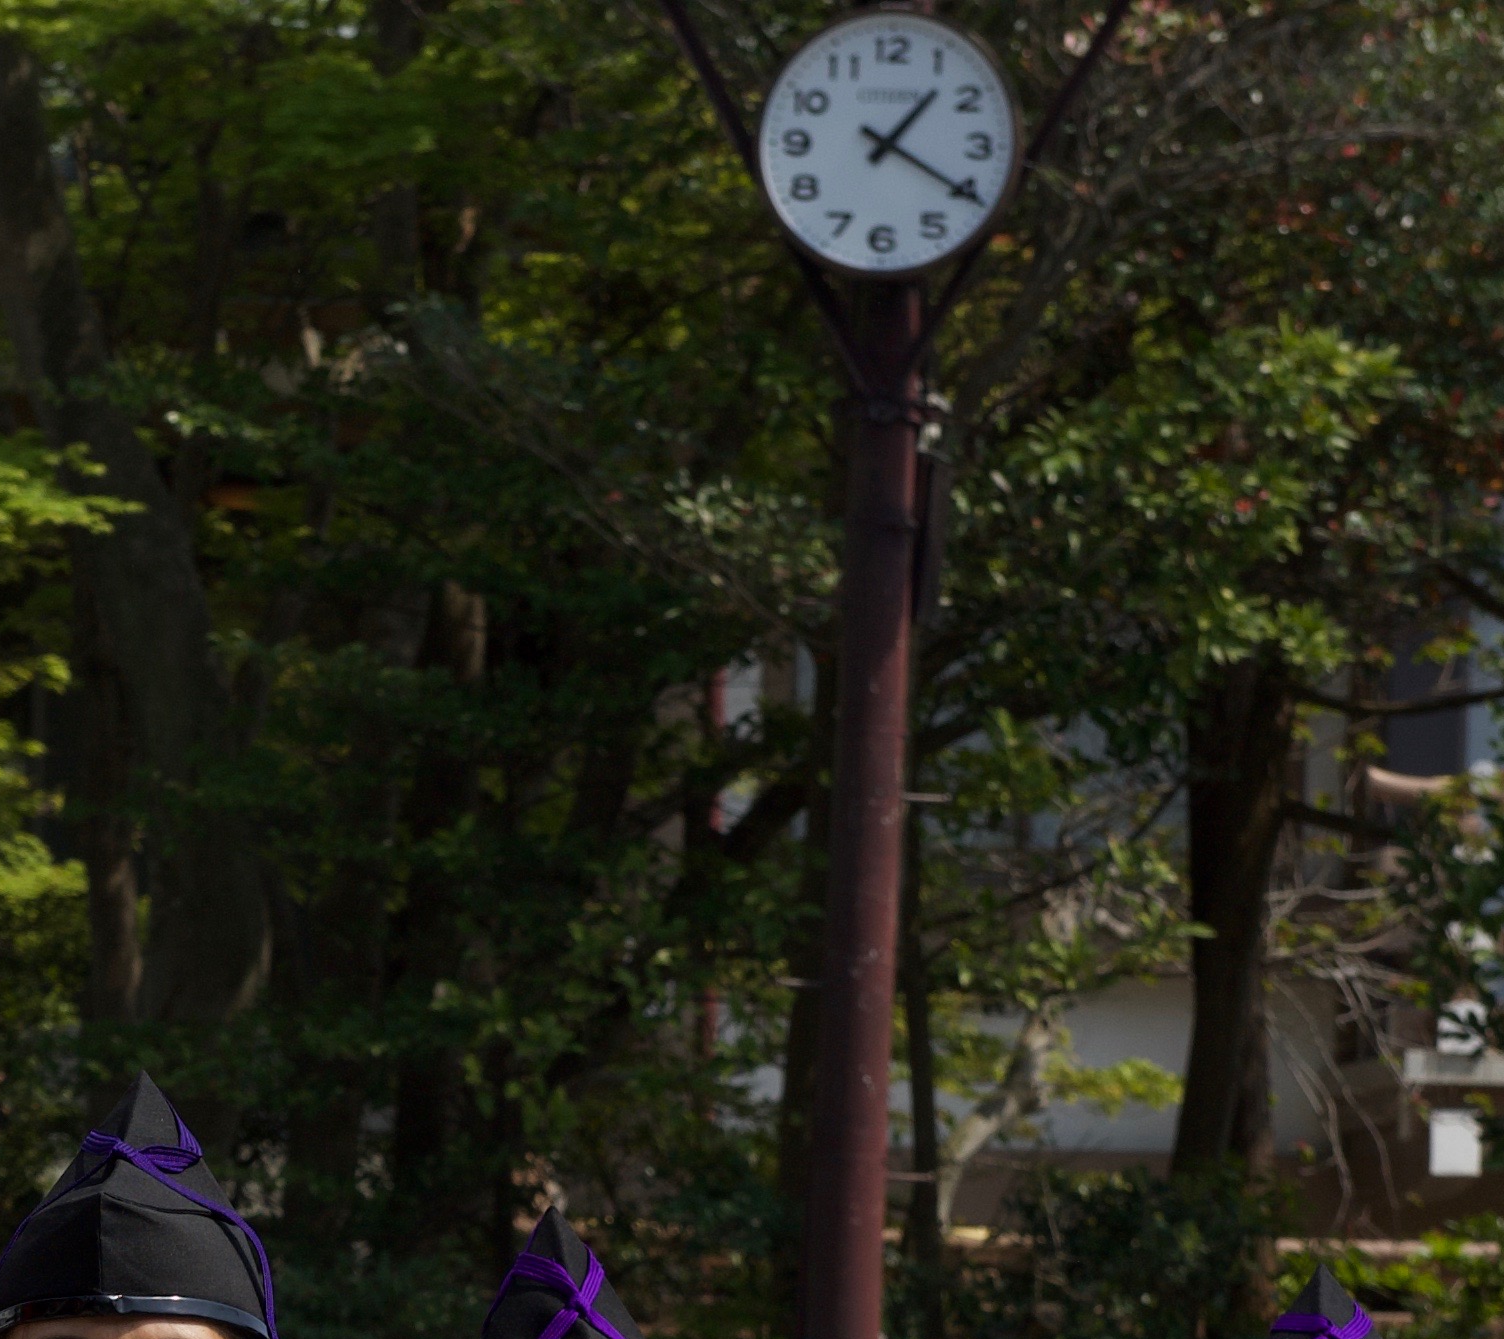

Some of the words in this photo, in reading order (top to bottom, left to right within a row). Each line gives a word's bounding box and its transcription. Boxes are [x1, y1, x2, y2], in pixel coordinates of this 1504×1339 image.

[874, 36, 911, 65] 12
[794, 89, 830, 116] 10
[954, 85, 983, 114] 2
[783, 129, 812, 157] 9
[964, 132, 993, 160] 3
[790, 174, 820, 201] 8
[825, 210, 855, 238] 7
[919, 210, 948, 240] 5
[866, 225, 897, 253] 6
